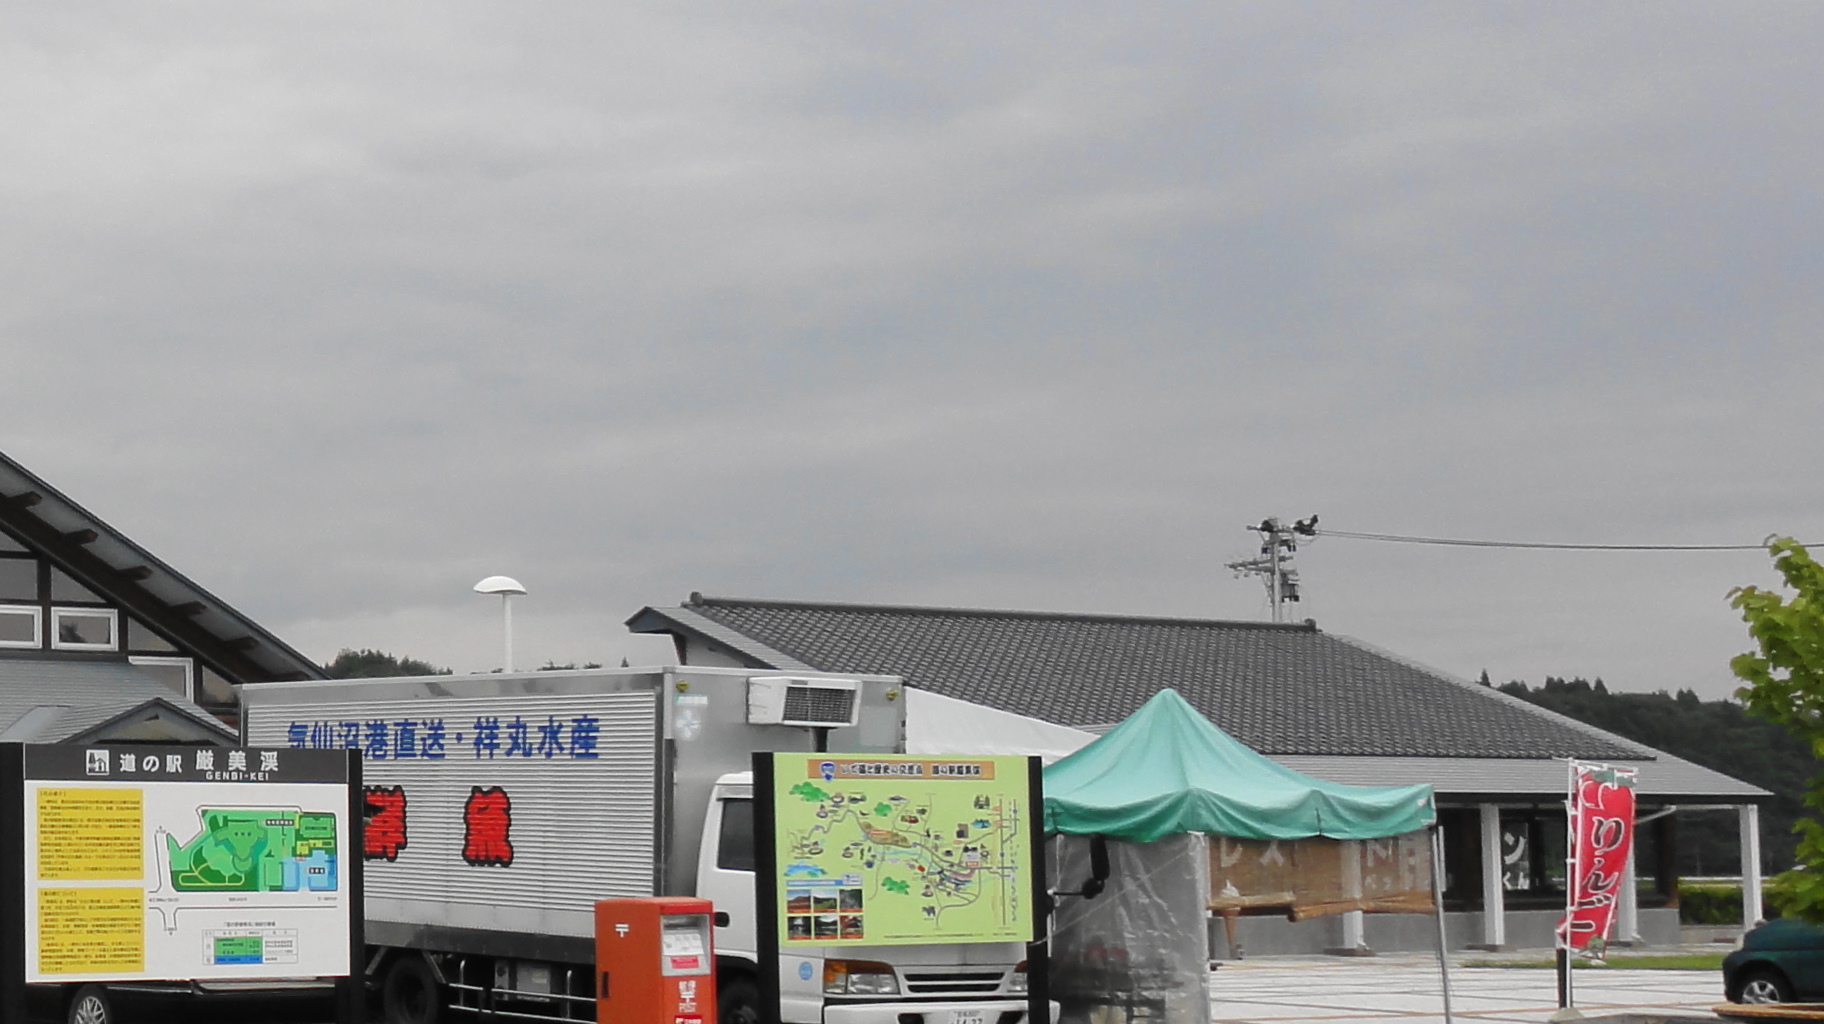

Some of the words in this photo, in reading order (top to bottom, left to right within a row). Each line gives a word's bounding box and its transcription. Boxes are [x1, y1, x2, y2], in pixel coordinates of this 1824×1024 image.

[119, 753, 183, 774] 道の駅
[195, 749, 279, 772] 厳美渓
[205, 771, 269, 782] GENBI-KEI
[1568, 816, 1624, 932] りんご
